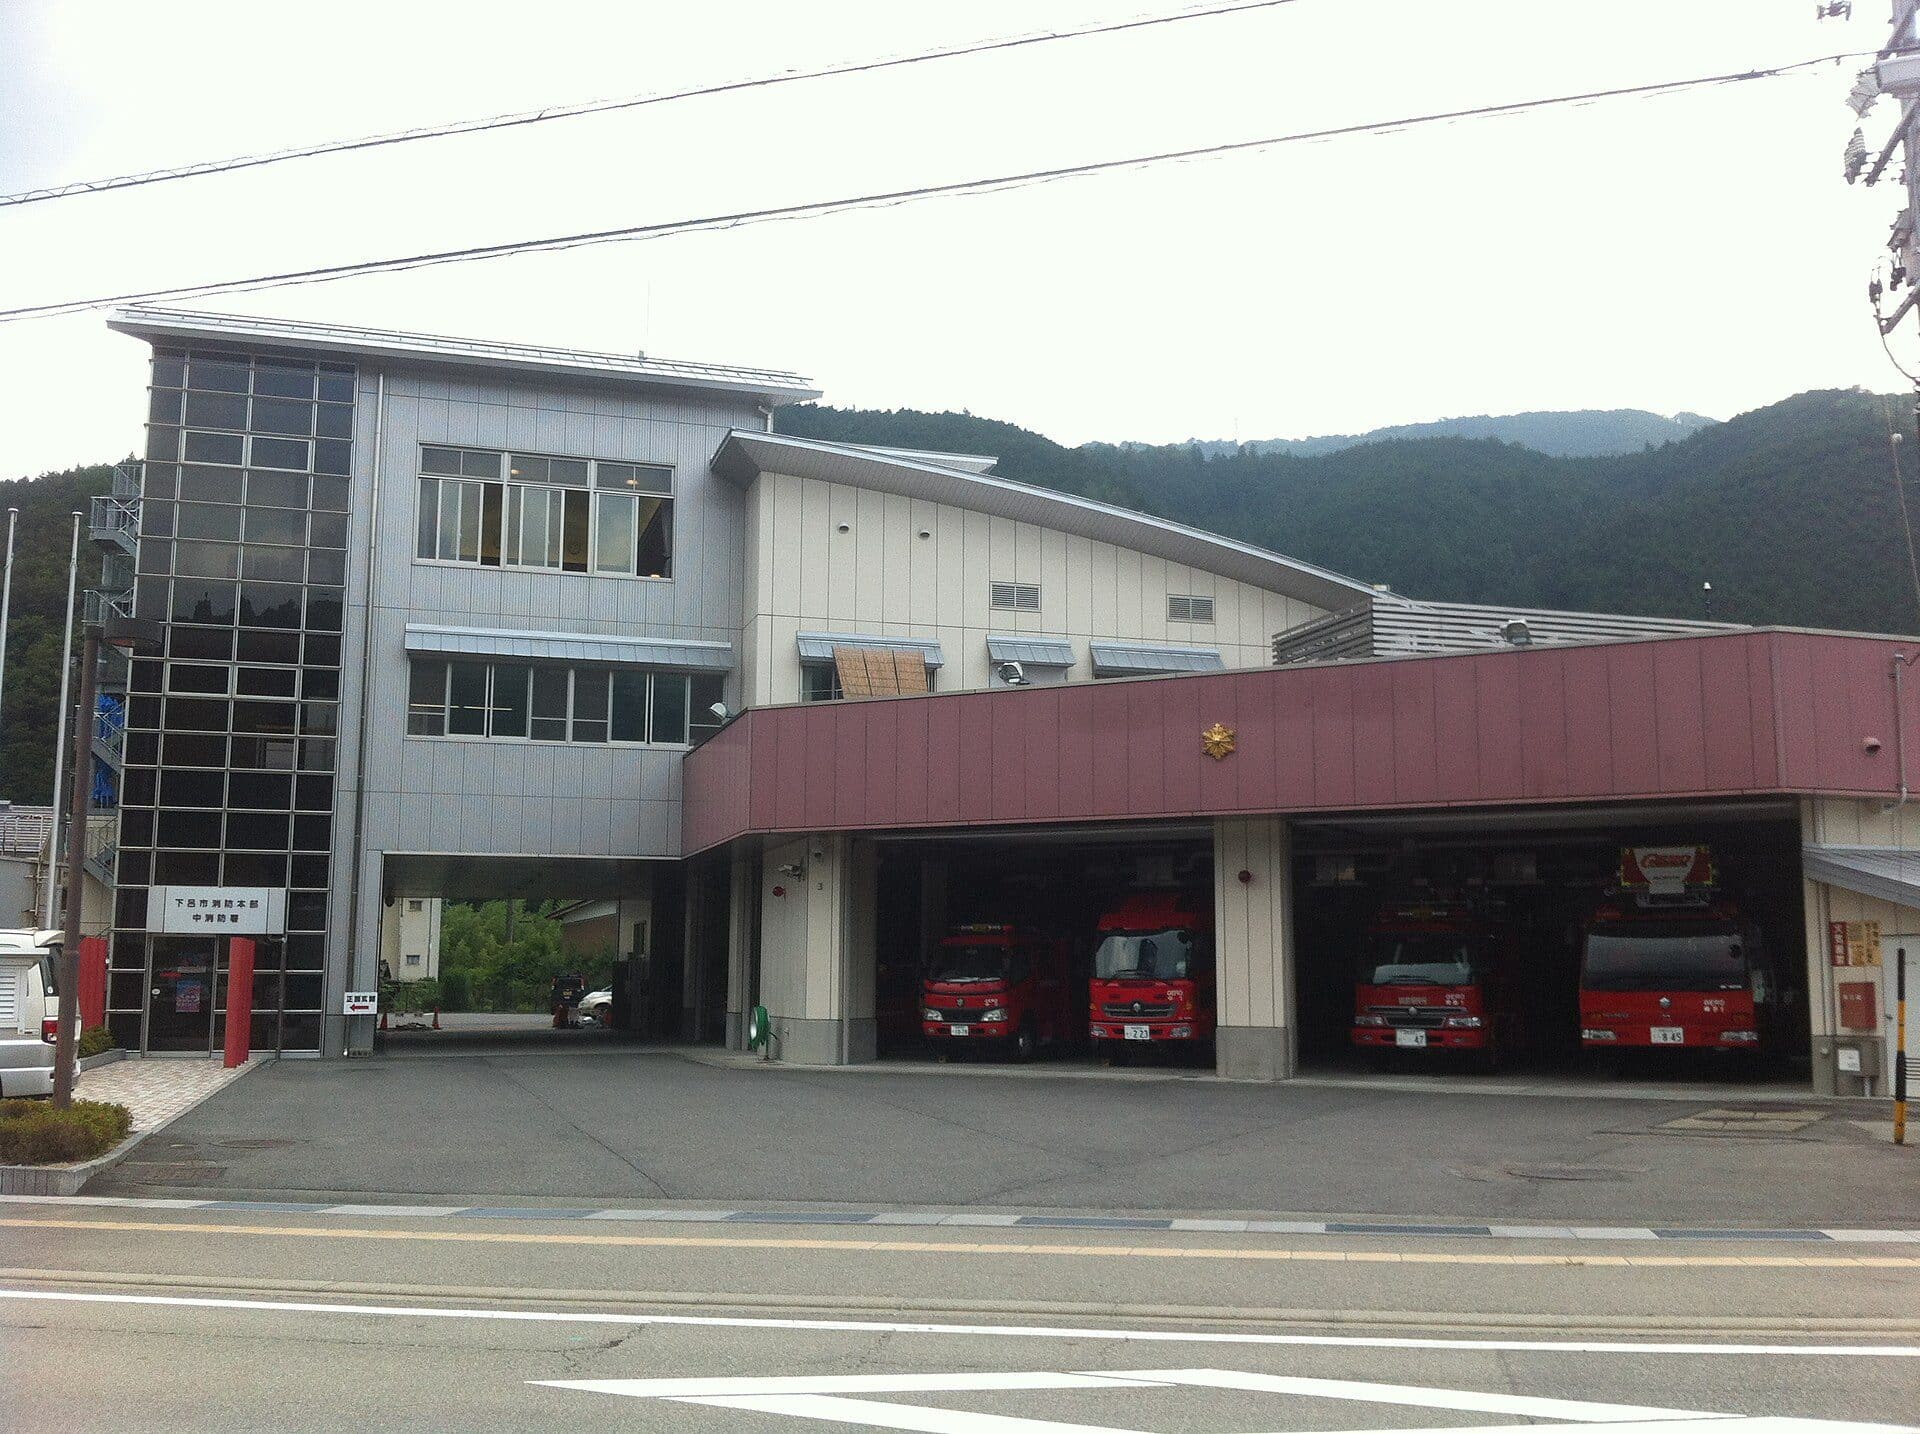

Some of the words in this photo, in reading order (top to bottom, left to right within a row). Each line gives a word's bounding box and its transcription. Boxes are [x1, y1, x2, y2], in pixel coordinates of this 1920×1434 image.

[174, 898, 259, 909] 下呂市消防本部
[192, 913, 239, 923] 中消防署
